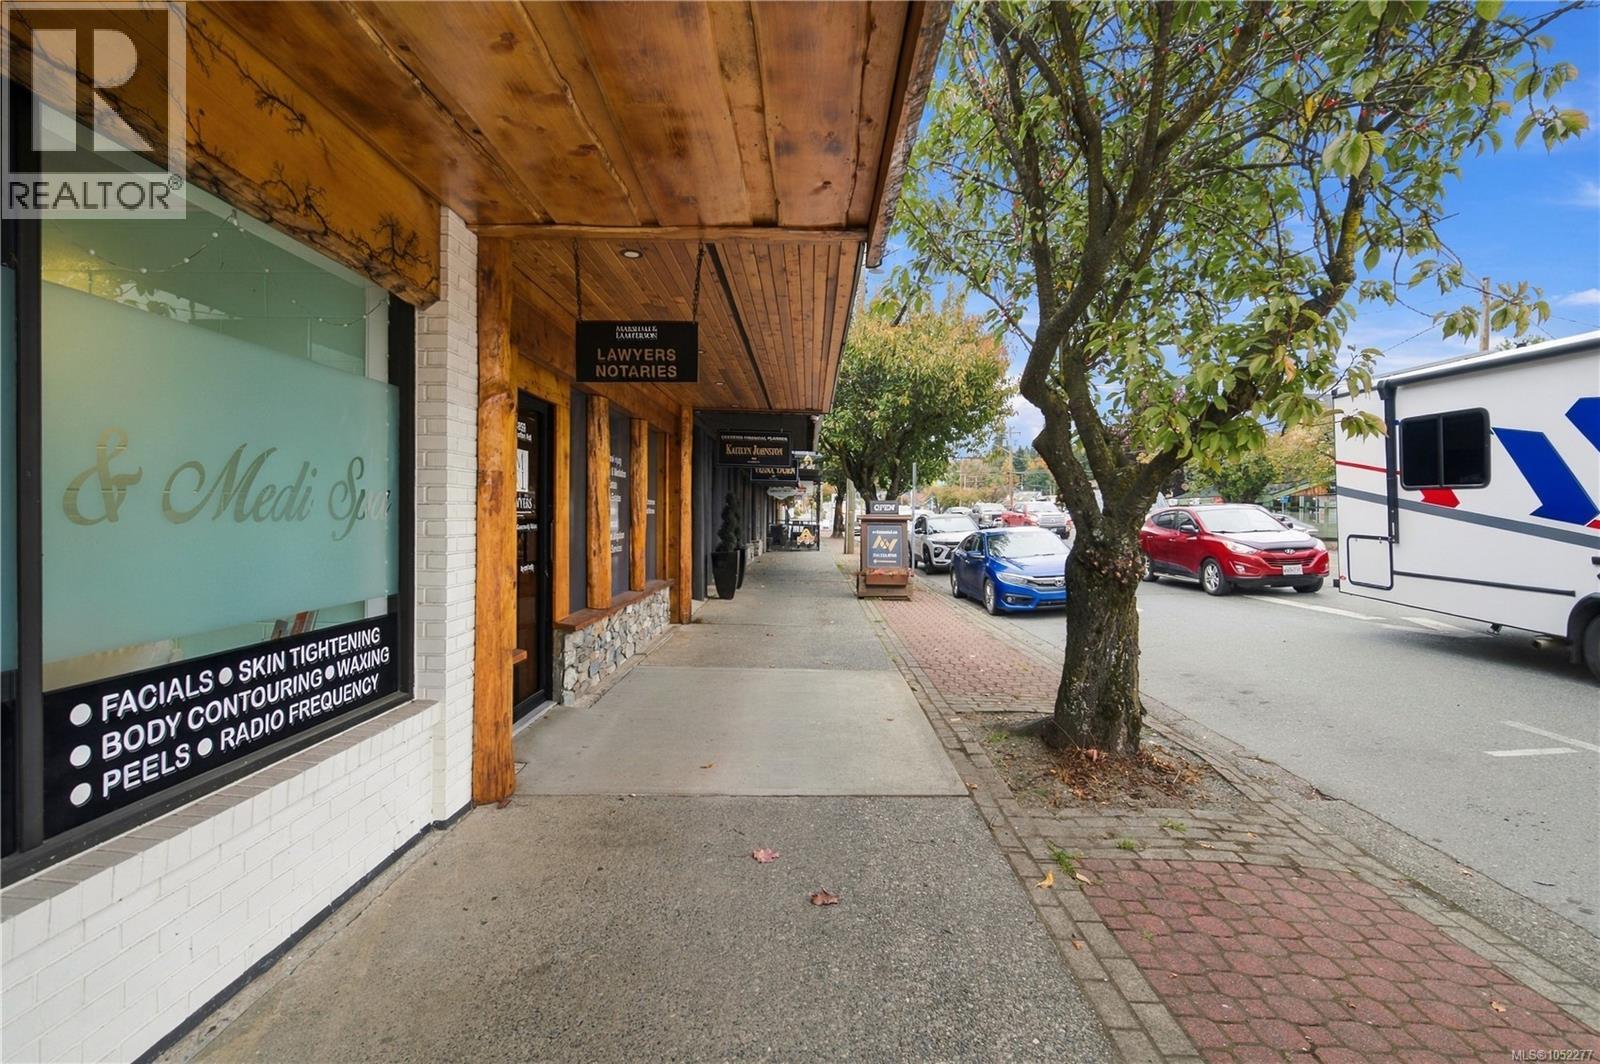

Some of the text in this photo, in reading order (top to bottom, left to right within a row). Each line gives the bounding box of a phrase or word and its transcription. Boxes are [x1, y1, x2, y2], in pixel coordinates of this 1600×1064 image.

[595, 365, 678, 378] NOTARIES
[597, 348, 677, 361] LAWYERS
[62, 426, 391, 541] & Medi Spa
[873, 504, 896, 512] OPEN
[100, 626, 382, 722] FACIALS SKIN TIGHTENING
[100, 645, 391, 761] BODY CONTOURING WAXING
[101, 673, 381, 799] PEELS RADIO FREQUENCY
